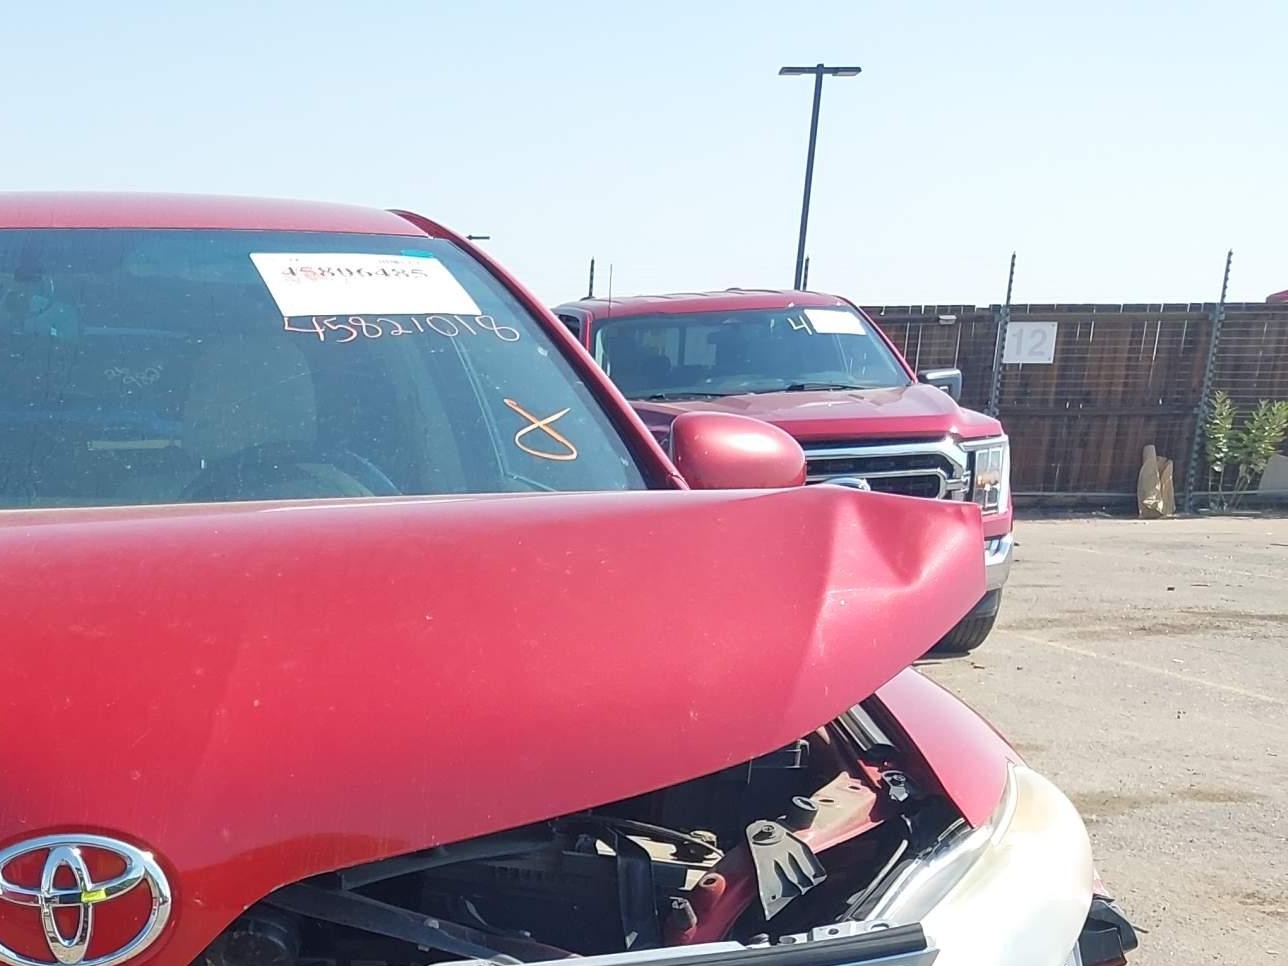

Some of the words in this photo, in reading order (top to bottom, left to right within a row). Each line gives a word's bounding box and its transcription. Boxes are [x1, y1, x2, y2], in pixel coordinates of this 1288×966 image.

[284, 315, 520, 342] 45821018
[787, 315, 812, 335] 4
[1012, 328, 1047, 356] 12
